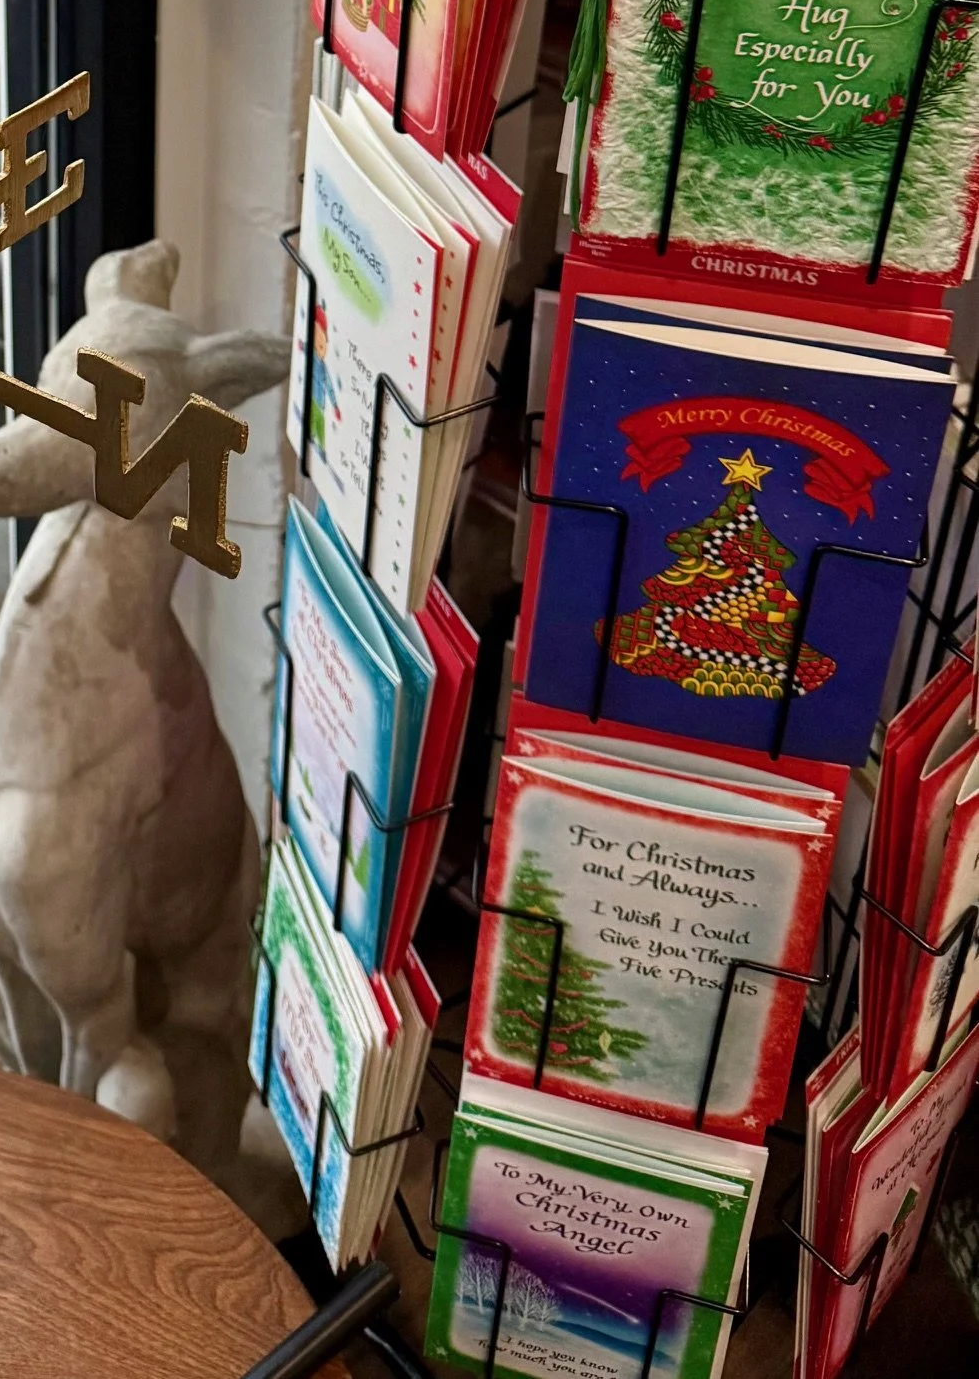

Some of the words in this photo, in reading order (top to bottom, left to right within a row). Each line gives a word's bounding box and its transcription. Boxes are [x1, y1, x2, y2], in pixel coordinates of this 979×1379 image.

[734, 32, 875, 80] Especially
[797, 81, 872, 121] You
[691, 256, 819, 286] CHRISTMAS
[657, 406, 733, 428] Merry
[739, 406, 857, 458] Christmas
[569, 824, 620, 853] For
[626, 840, 756, 883] Christmas
[583, 860, 624, 883] and
[629, 868, 760, 909] Always...
[591, 899, 608, 915] I
[612, 904, 662, 929] Wish
[669, 917, 683, 933] I
[690, 922, 752, 946] Could
[597, 927, 641, 950] Give
[647, 939, 688, 960] You
[620, 956, 663, 980] Five
[494, 1161, 521, 1179] To
[525, 1172, 571, 1198] My
[572, 1184, 633, 1215] Very
[639, 1205, 691, 1229] Own
[515, 1189, 662, 1242] Christmas
[529, 1218, 635, 1256] Angel
[510, 1350, 547, 1366] much
[547, 1362, 577, 1375] you
[517, 1339, 548, 1353] hope
[549, 1350, 576, 1363] you
[580, 1357, 619, 1375] know
